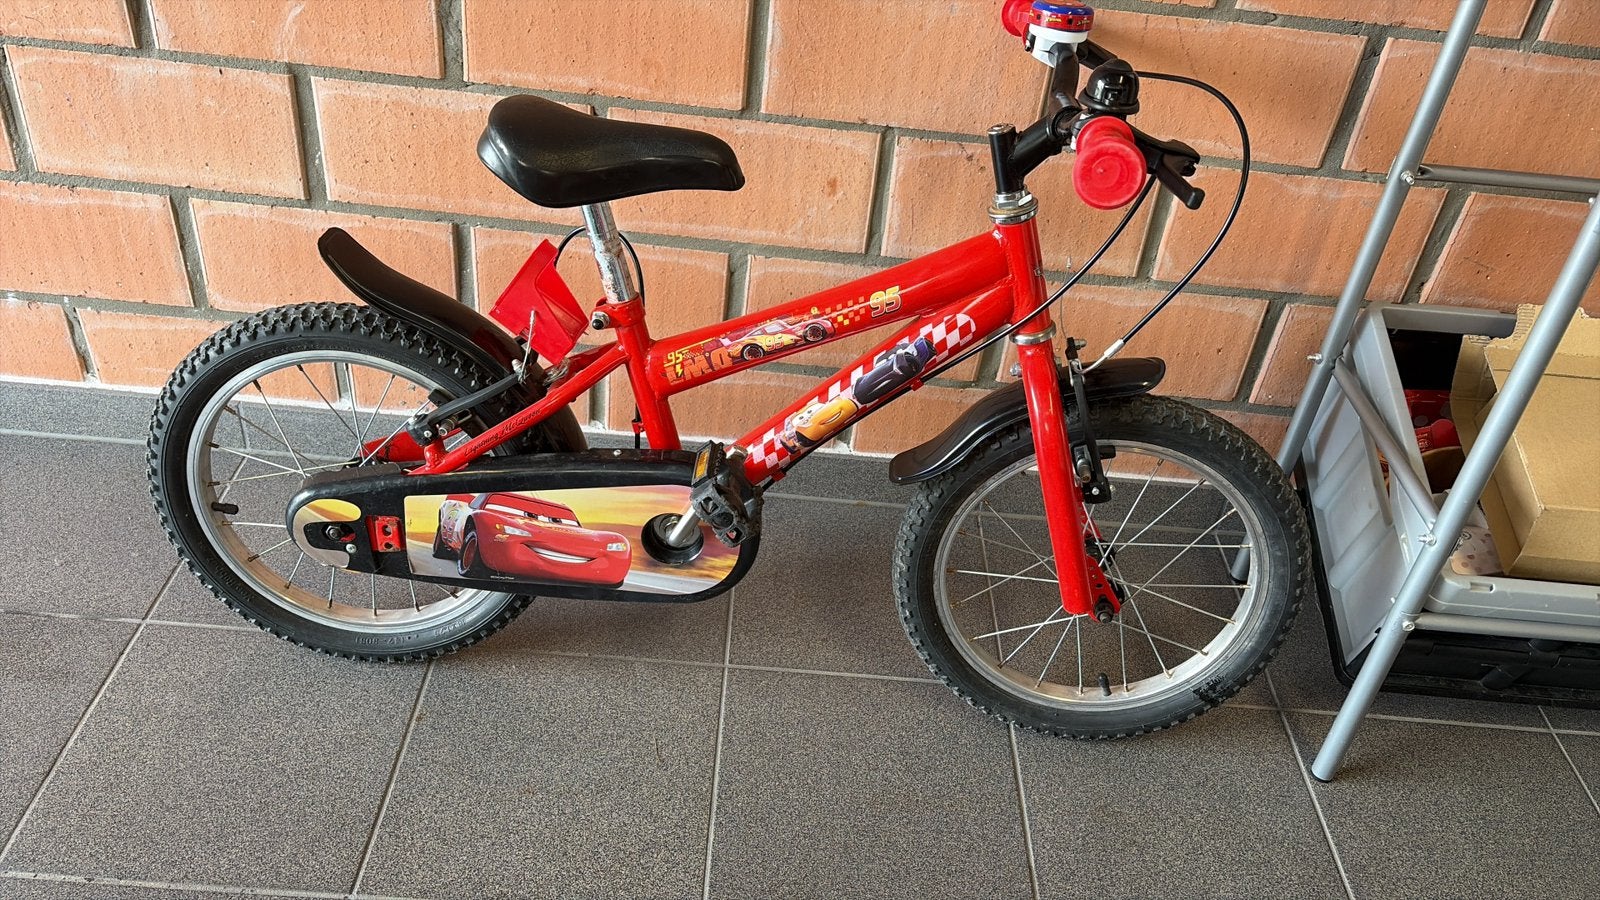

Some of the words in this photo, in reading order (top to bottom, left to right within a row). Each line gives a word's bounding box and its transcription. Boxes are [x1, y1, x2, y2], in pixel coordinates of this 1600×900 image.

[870, 285, 901, 318] 95
[765, 335, 785, 352] 95
[667, 350, 683, 365] 95
